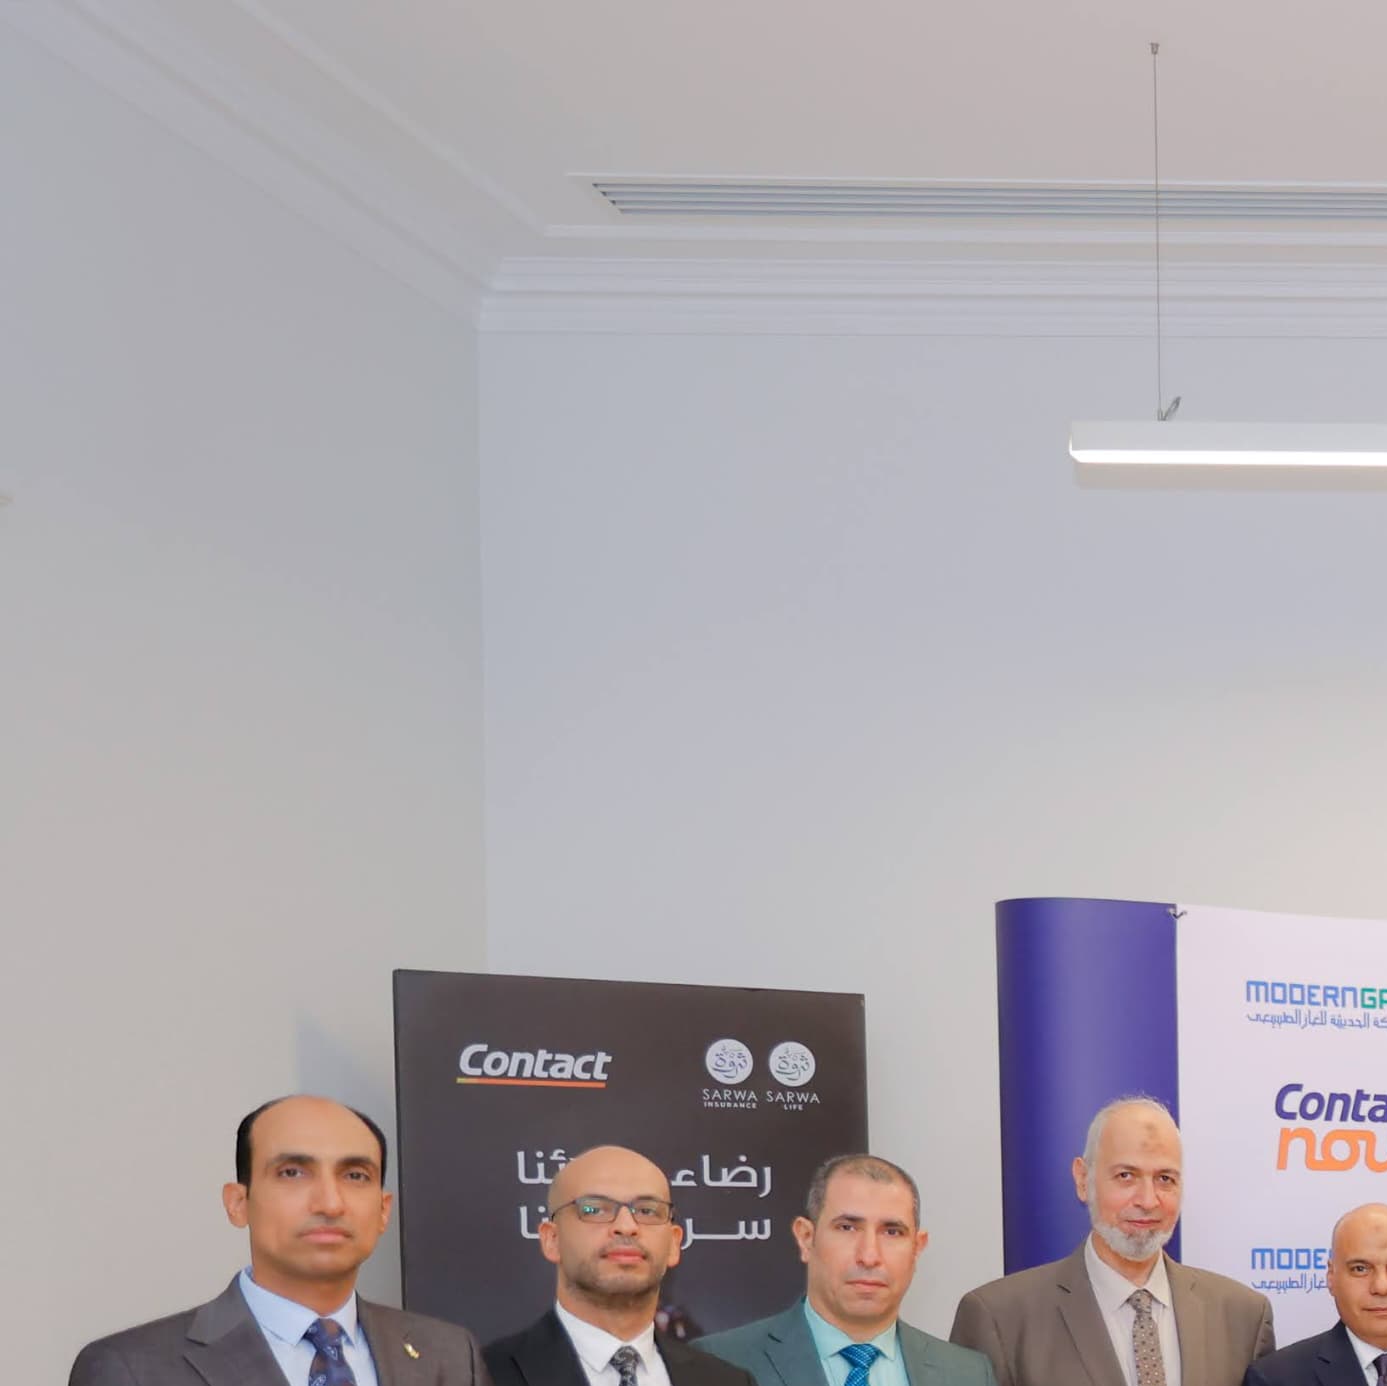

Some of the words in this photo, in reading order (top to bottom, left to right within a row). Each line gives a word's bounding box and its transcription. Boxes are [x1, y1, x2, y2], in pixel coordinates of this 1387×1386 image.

[459, 1043, 612, 1081] Contact
[702, 1088, 758, 1101] SARWA
[766, 1090, 820, 1104] SARWA
[704, 1101, 758, 1110] INSURANCE
[672, 1154, 772, 1197] رضاء
